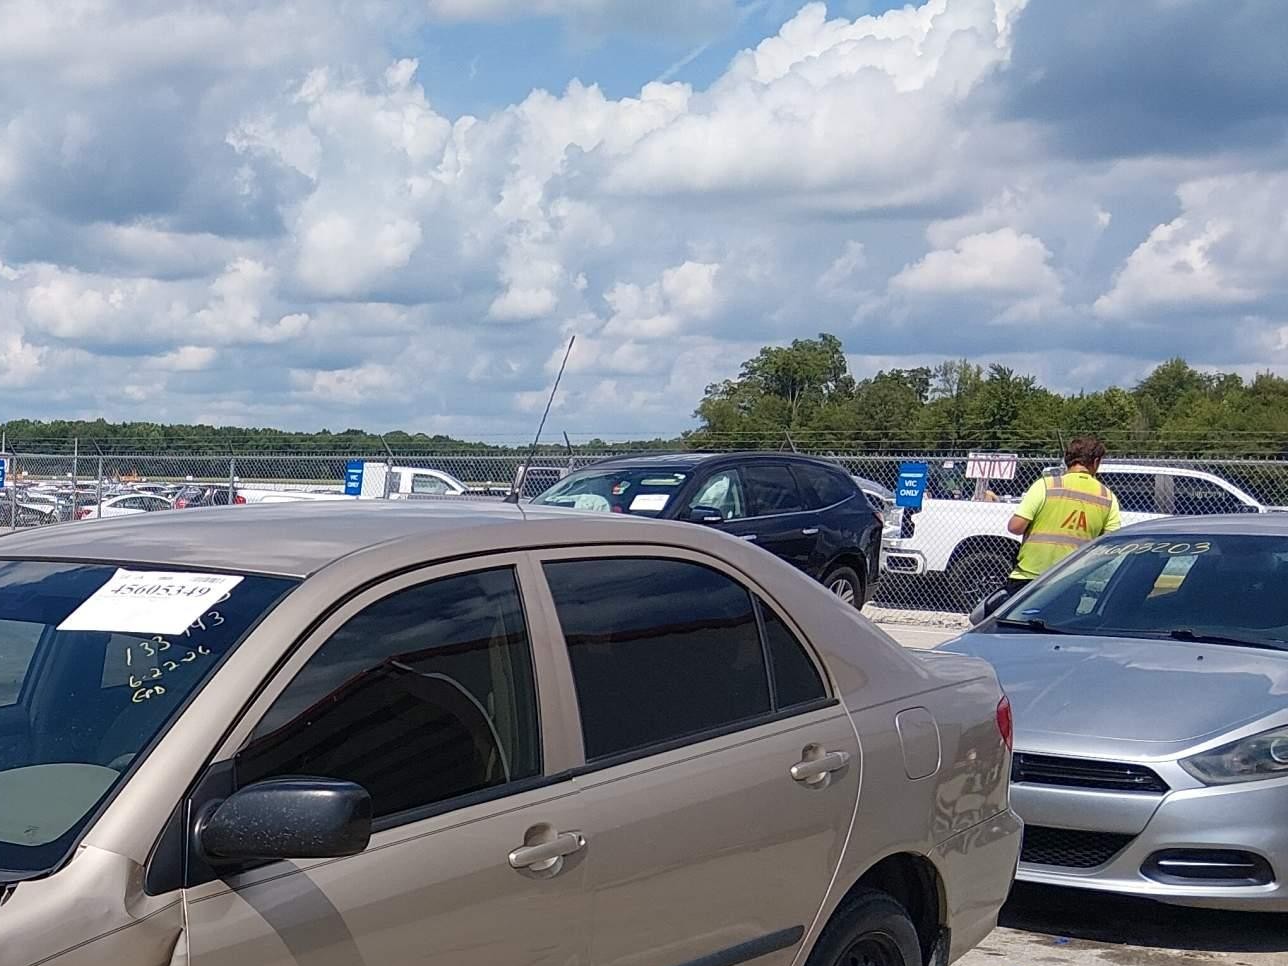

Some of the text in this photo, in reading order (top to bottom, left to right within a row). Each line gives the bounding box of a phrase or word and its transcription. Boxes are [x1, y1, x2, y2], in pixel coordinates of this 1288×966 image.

[904, 479, 918, 488] VIC
[899, 489, 920, 497] ONLY
[111, 584, 212, 597] 45605349
